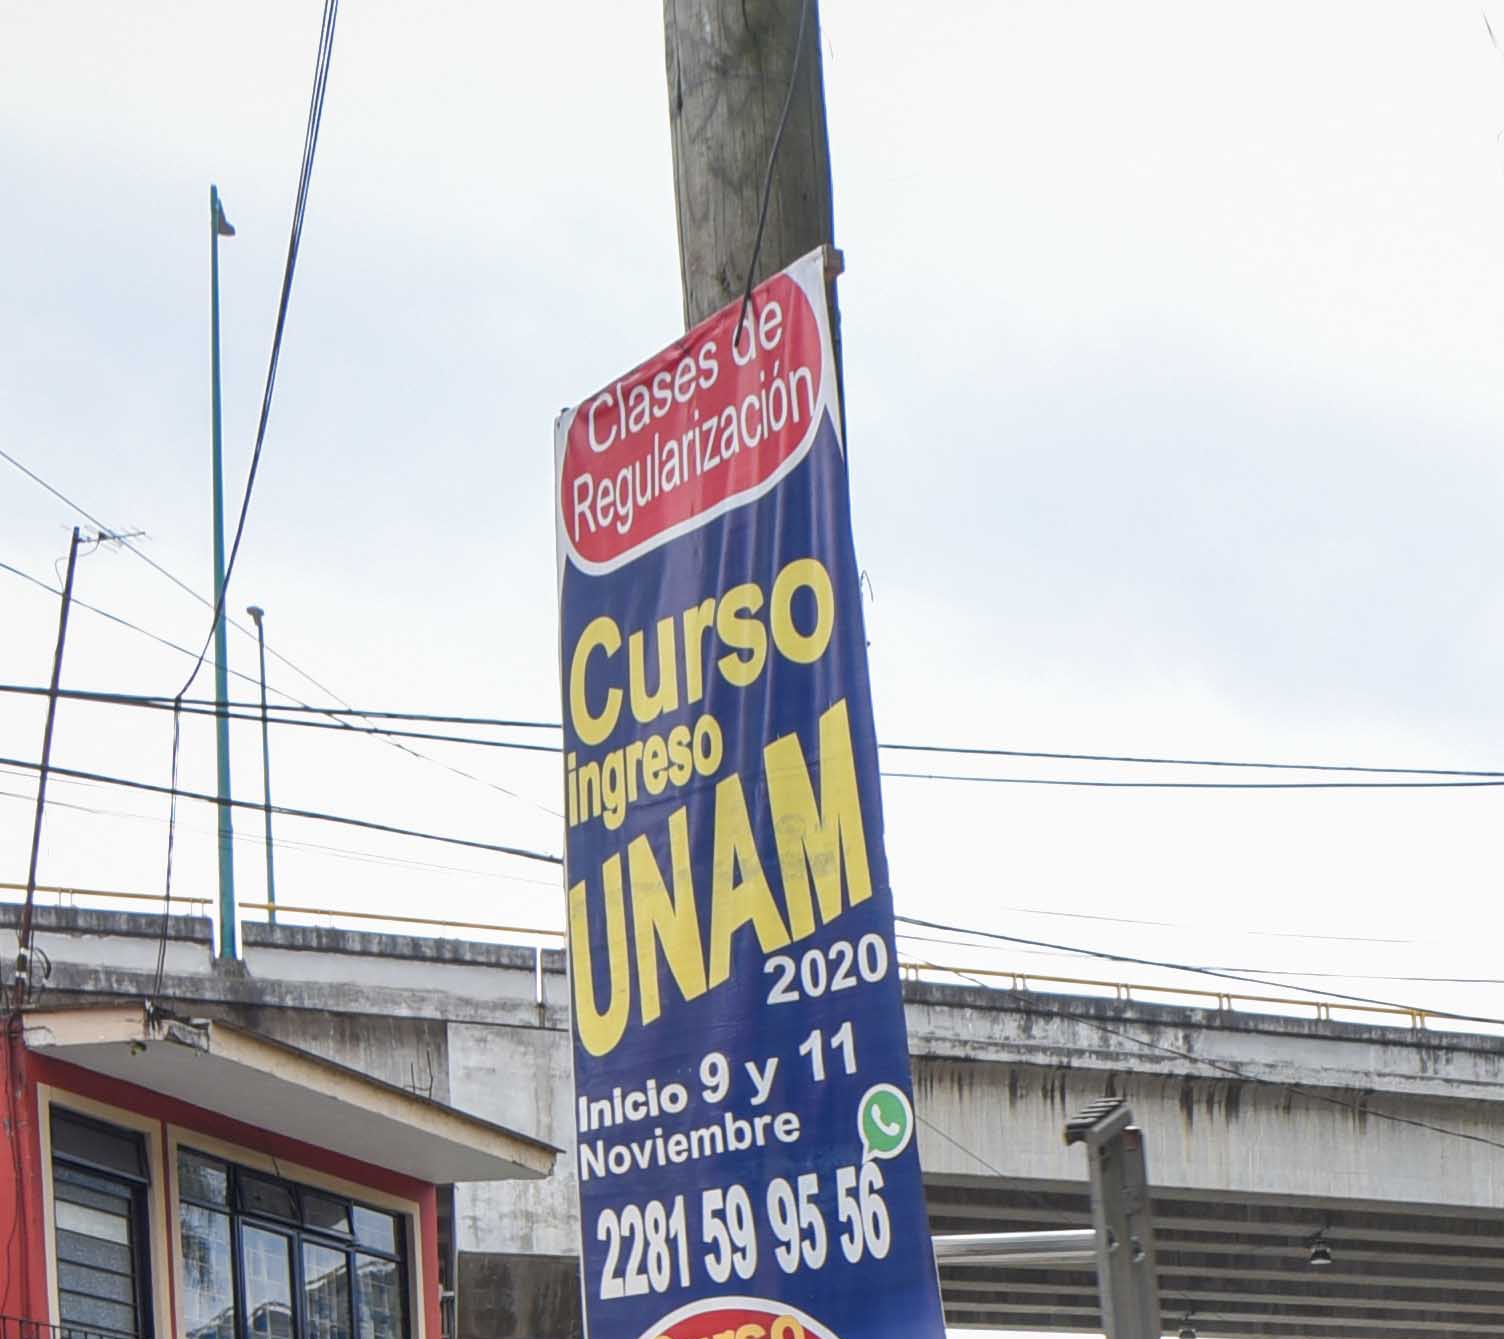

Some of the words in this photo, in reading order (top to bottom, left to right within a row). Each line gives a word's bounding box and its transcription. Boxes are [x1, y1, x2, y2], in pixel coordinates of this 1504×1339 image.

[586, 338, 719, 455] Clases
[732, 299, 783, 369] de
[572, 362, 820, 544] Regularización
[569, 556, 836, 747] Curso
[567, 713, 725, 832] ingreso
[567, 698, 874, 1057] UNAM
[763, 932, 889, 1006] 2020
[578, 1078, 688, 1133] Inicio
[698, 1050, 730, 1106] 9
[743, 1055, 778, 1106] y
[799, 1021, 859, 1083] 11
[579, 1108, 801, 1182] Noviembre
[597, 1194, 692, 1300] 2281
[702, 1183, 757, 1284] 59
[767, 1173, 827, 1275] 95
[836, 1161, 892, 1266] 56
